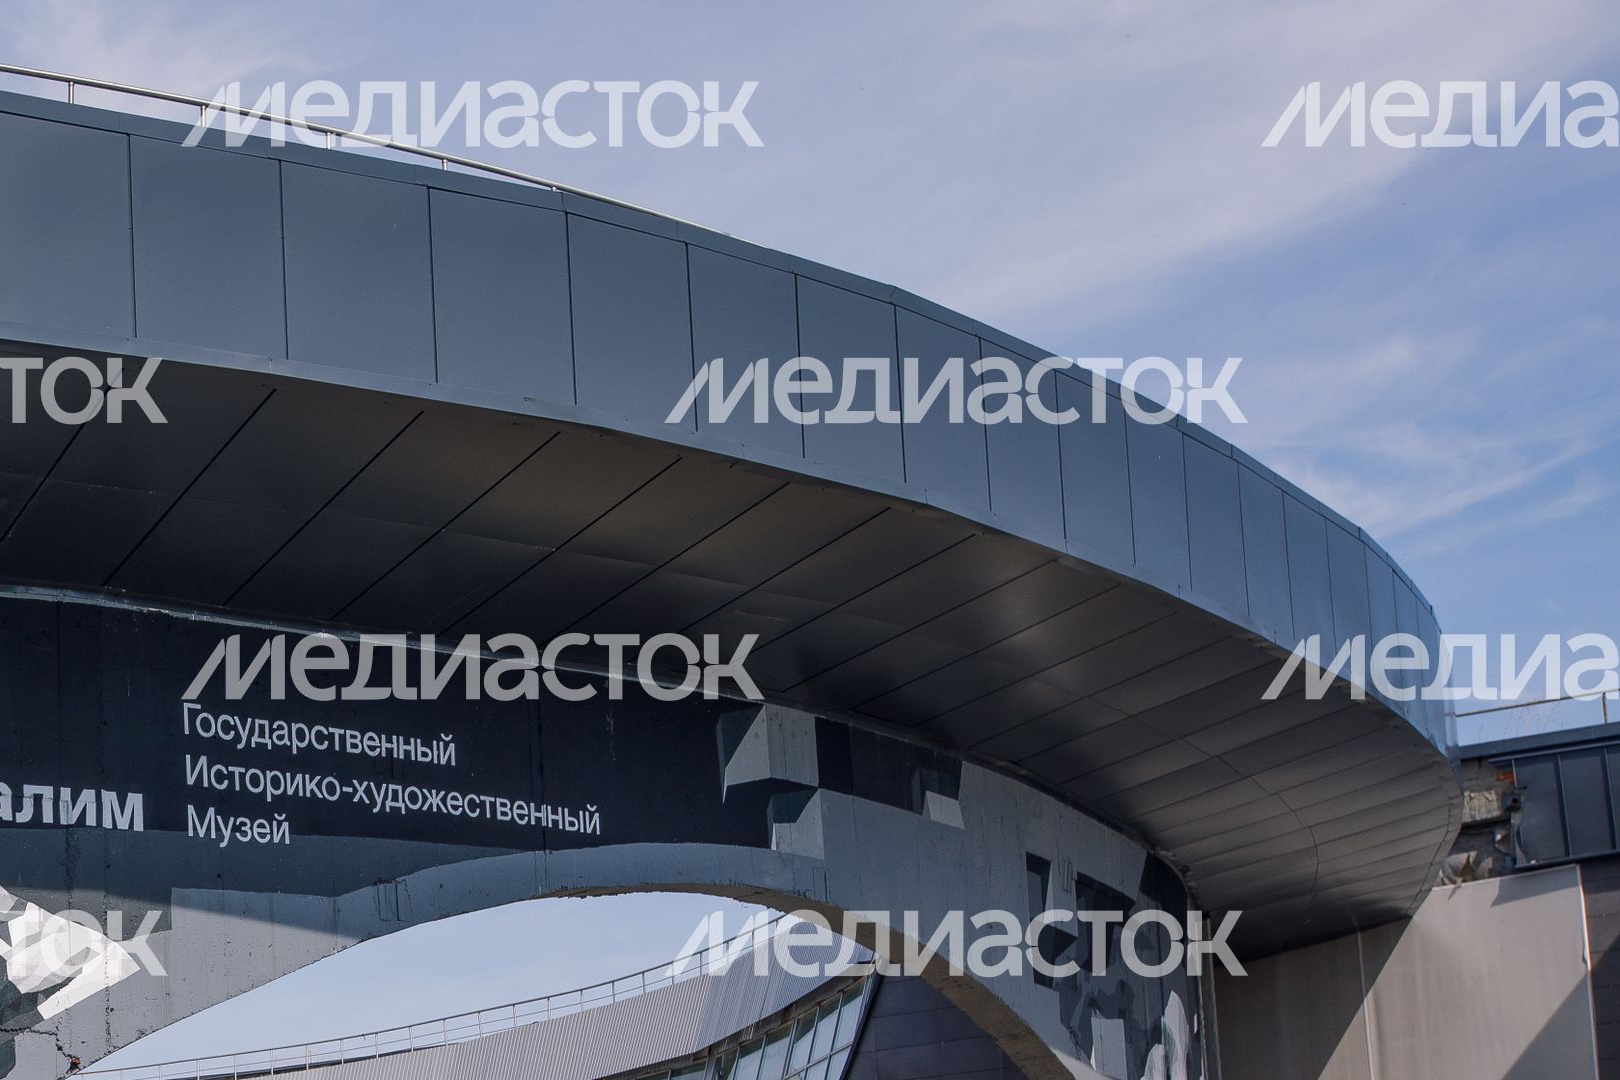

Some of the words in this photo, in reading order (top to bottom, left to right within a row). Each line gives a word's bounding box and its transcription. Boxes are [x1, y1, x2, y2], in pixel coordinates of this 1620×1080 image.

[182, 702, 457, 766] Государственный
[185, 755, 601, 835] Историко-художественный
[187, 805, 291, 848] Музей
